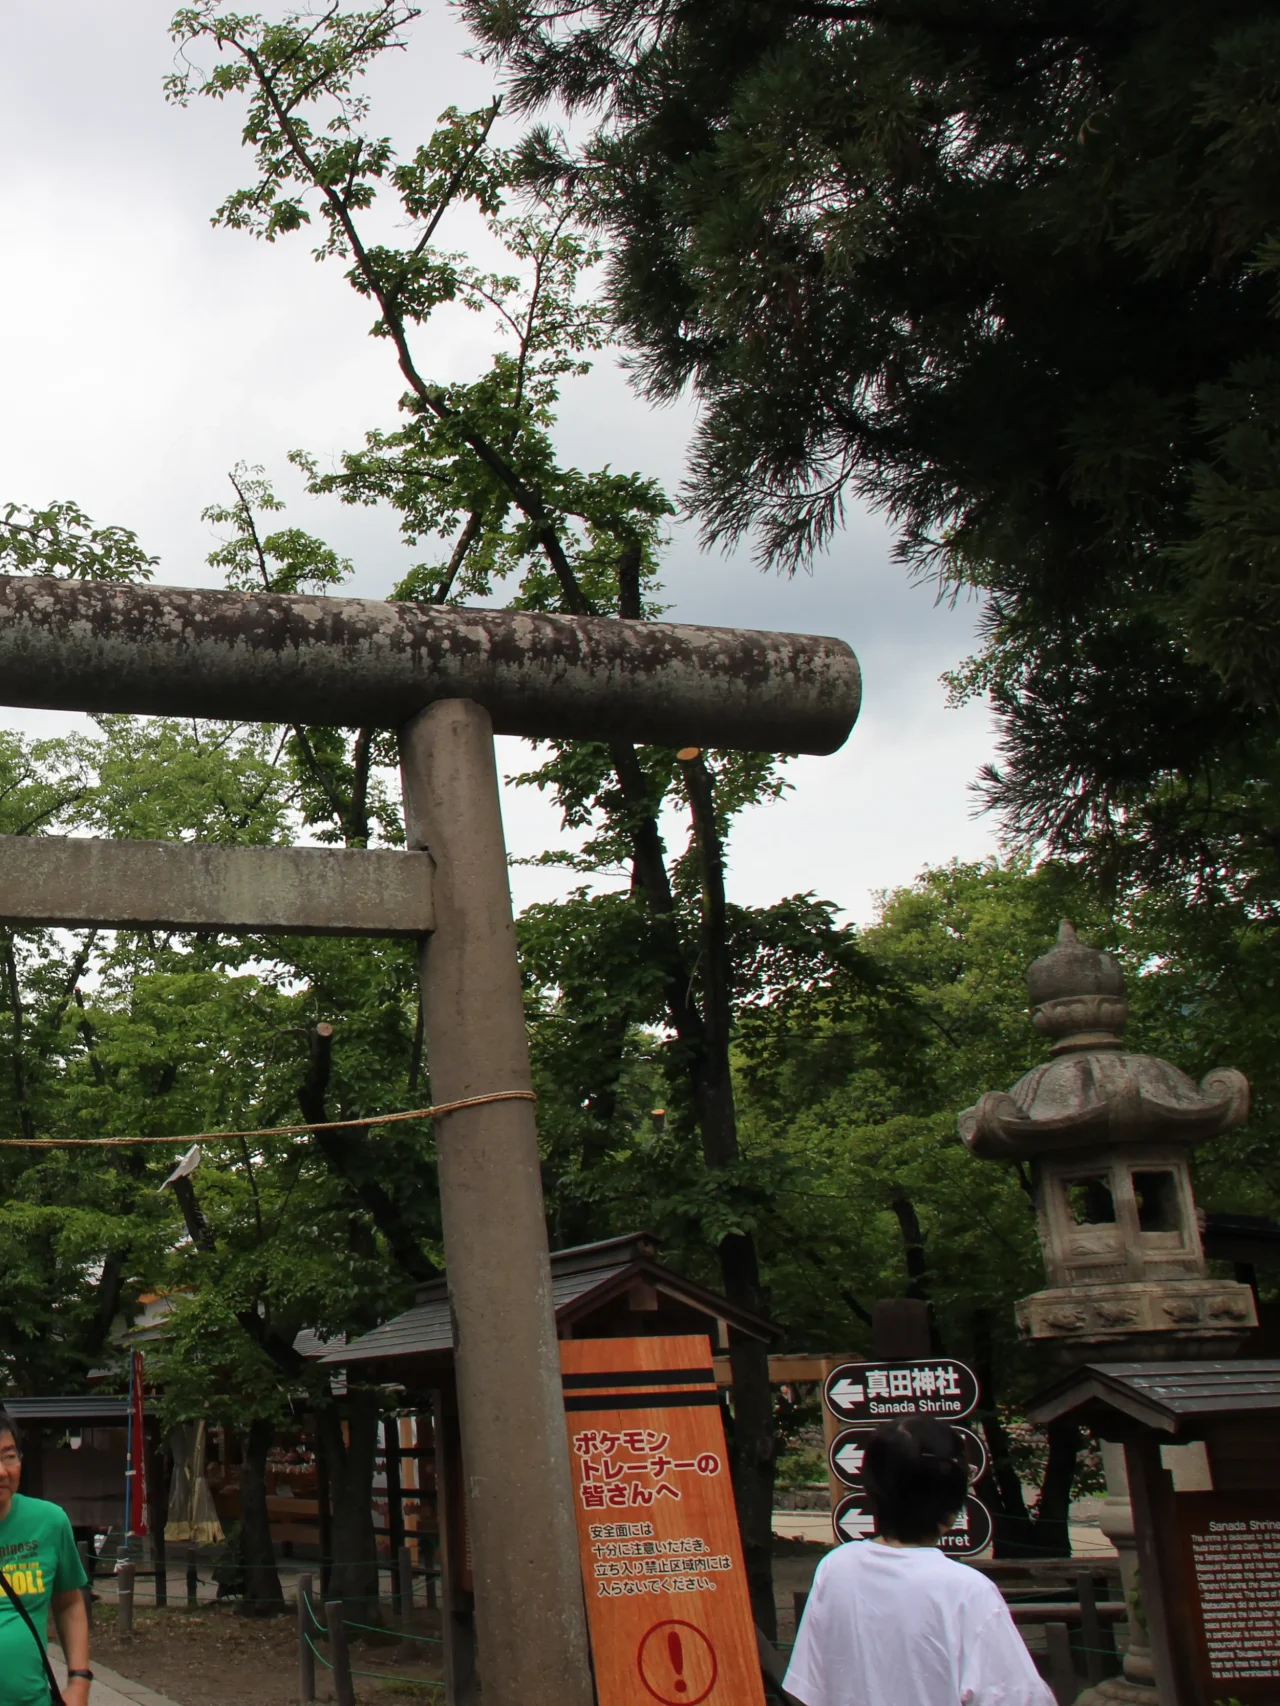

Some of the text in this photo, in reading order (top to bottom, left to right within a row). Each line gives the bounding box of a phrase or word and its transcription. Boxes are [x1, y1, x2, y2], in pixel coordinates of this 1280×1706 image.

[865, 1366, 961, 1399] 真田神社
[869, 1399, 961, 1414] Sanada Shrine
[574, 1430, 670, 1457] ポケモン
[581, 1452, 721, 1482] トレーナーの
[580, 1481, 681, 1510] 皆さんへ
[589, 1521, 654, 1539] 安全面には
[1210, 1521, 1246, 1531] Sanada
[593, 1537, 711, 1559] 十分に注意いただき、
[594, 1556, 732, 1578] 立ち入り禁止区域内には
[598, 1576, 716, 1597] 入らないでください。
